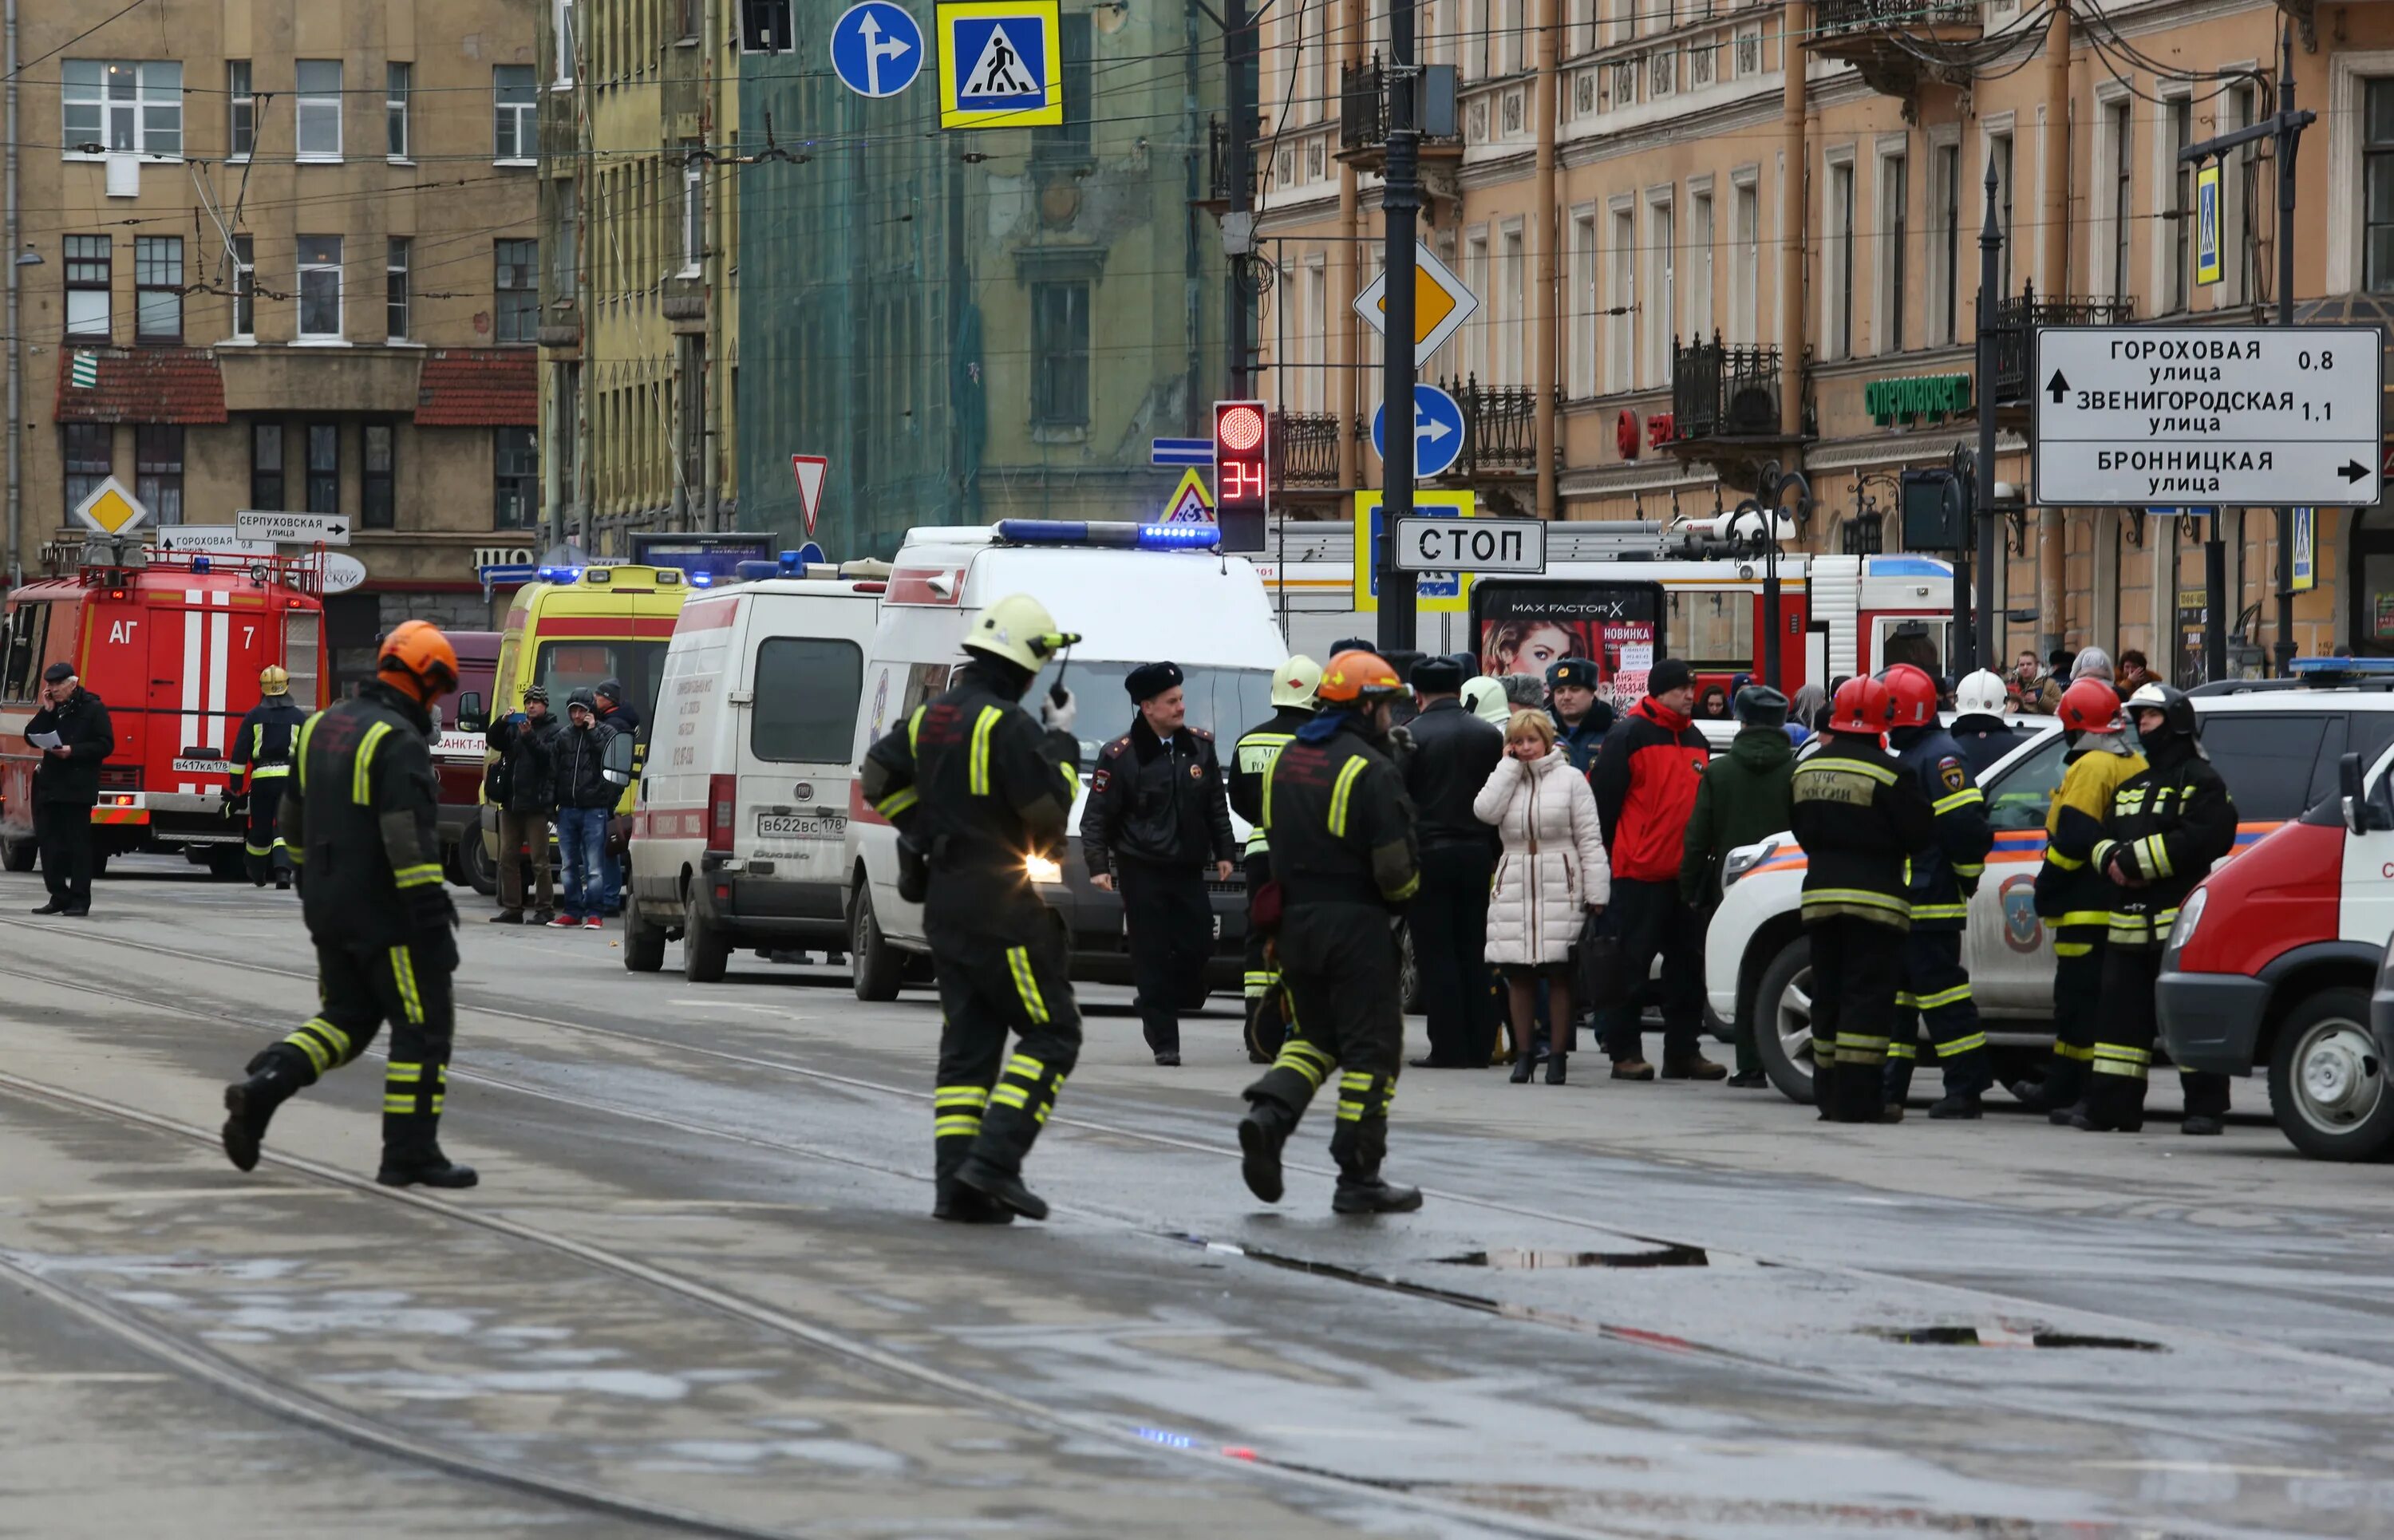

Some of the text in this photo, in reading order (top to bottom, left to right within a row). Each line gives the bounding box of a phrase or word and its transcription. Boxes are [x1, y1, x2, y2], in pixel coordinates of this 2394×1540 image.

[2111, 341, 2334, 371] ГОРОХОВАЯ 0,8
[2149, 365, 2221, 385] улица
[1865, 373, 1969, 427] супермаркет
[2076, 391, 2333, 423] ЗВЕНИГОРОДСКАЯ 1,1
[2149, 416, 2221, 436] улица
[2098, 451, 2274, 473] БРОННИЦКАЯ
[1223, 461, 1262, 499] 34
[2148, 476, 2220, 496] улица
[239, 515, 323, 528] СЕРПУХОВСКАЯ
[176, 536, 233, 546] ГОРОХОВАЯ
[266, 529, 295, 538] улица
[1419, 528, 1522, 561] СТОП
[1512, 604, 1545, 614] MAX
[1549, 604, 1608, 614] FACTOR
[109, 620, 137, 644] АГ
[243, 626, 255, 650] 7
[1604, 627, 1649, 640] НОВИНКА
[437, 738, 485, 750] САНКТ-П
[176, 760, 212, 771] В417КА
[764, 819, 843, 832] В622ВС 178
[2382, 863, 2394, 879] С
